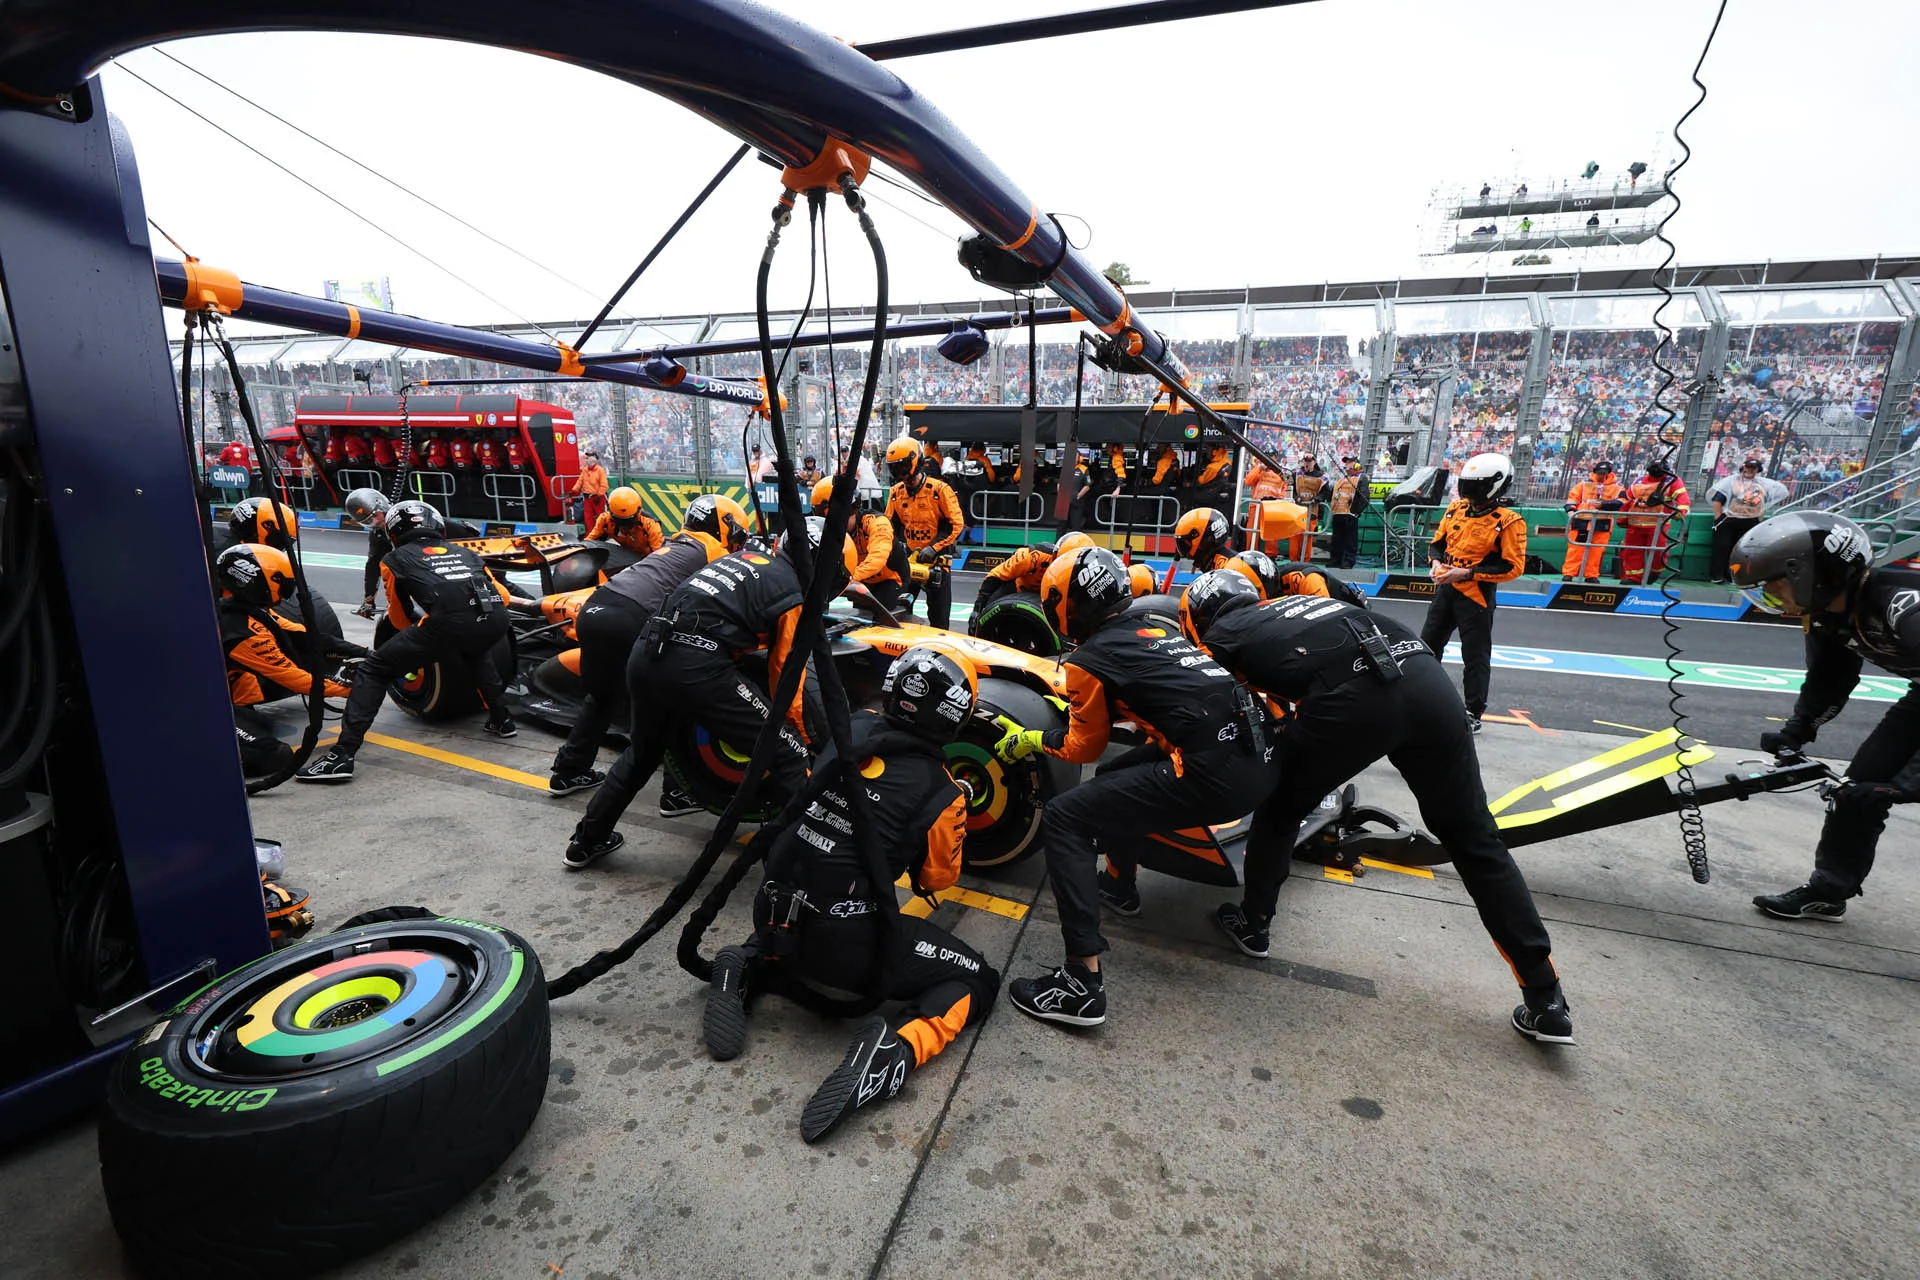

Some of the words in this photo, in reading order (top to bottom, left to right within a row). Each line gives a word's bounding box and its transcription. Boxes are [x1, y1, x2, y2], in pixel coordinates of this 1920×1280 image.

[709, 381, 725, 393] DP
[726, 385, 764, 401] WORLD
[213, 467, 245, 486] allwyn
[757, 485, 807, 505] alln
[1824, 524, 1852, 554] ON
[1077, 560, 1102, 587] ON
[945, 685, 972, 706] ON
[752, 697, 770, 719] OPTI
[936, 706, 960, 723] NUTRITION
[939, 701, 964, 718] OPTIMUM
[823, 789, 848, 808] ndroid
[824, 816, 854, 836] NUTRITION
[827, 811, 852, 827] OPTIMUM
[914, 940, 937, 958] ON
[939, 947, 980, 974] OPTIMUM
[140, 1056, 278, 1113] Cinturato
